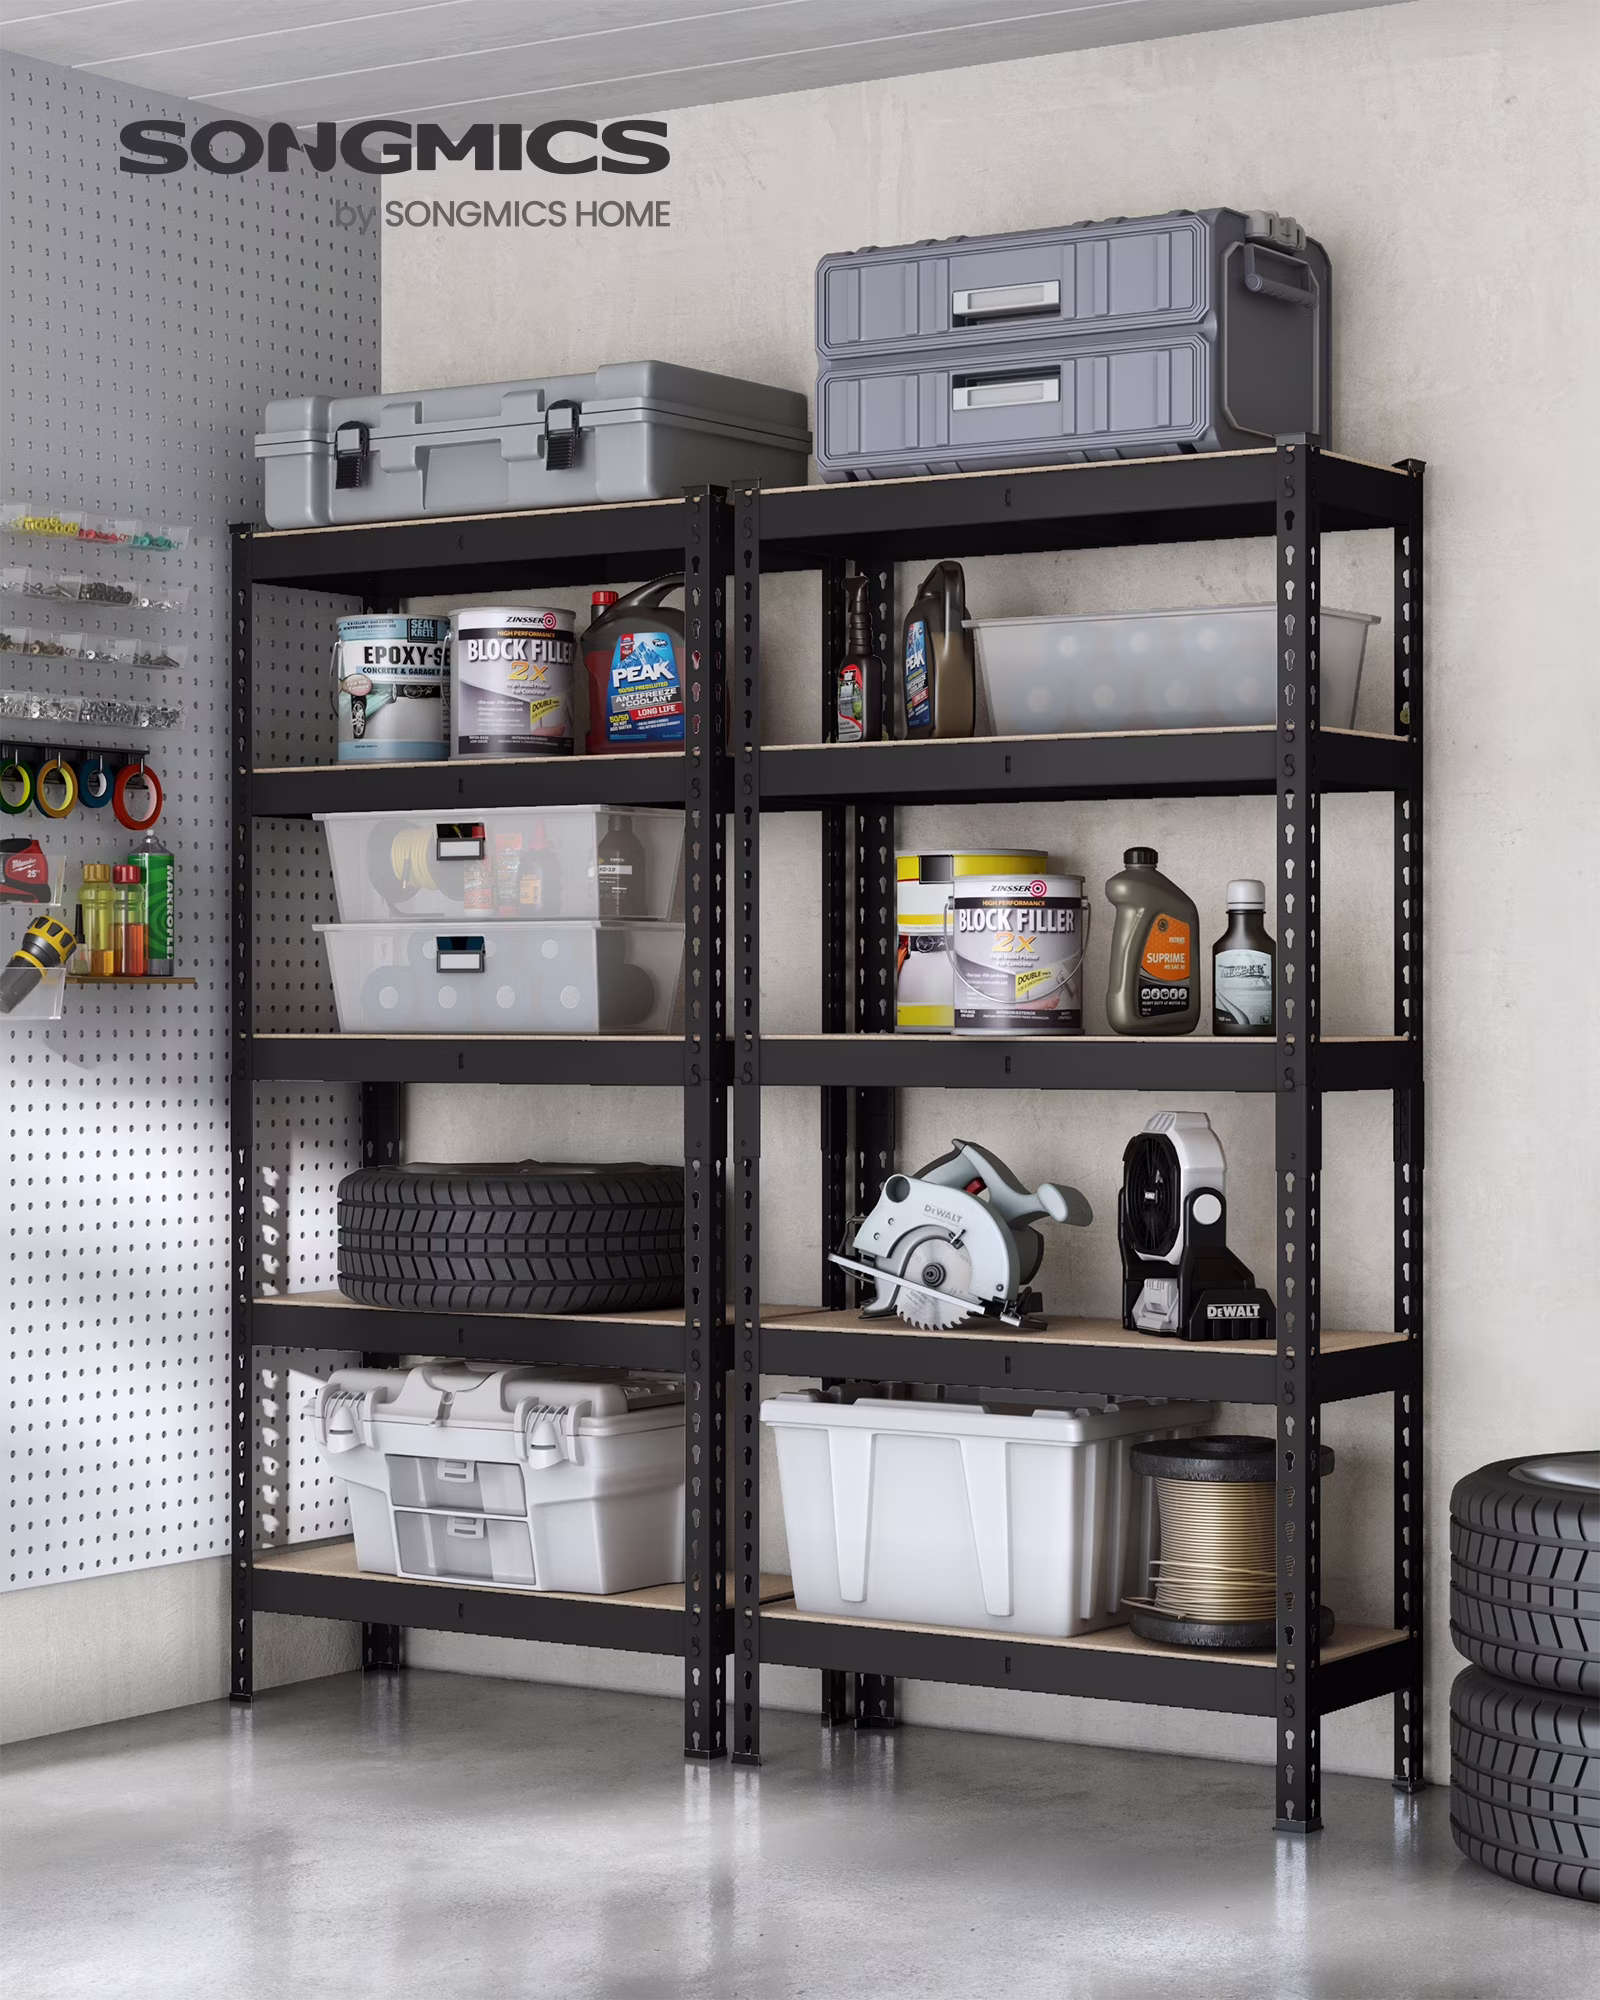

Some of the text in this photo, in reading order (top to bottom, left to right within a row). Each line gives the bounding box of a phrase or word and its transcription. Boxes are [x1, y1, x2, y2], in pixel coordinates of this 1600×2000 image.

[410, 619, 434, 629] SEAL
[411, 629, 435, 638] KRETE
[514, 630, 555, 638] PERFORMANCE
[467, 639, 527, 661] BLOCK
[906, 649, 926, 676] PEAK
[362, 667, 398, 675] CONCRETE
[408, 668, 436, 676] GARAGE
[612, 660, 676, 688] PEAK
[615, 688, 677, 703] ANTIFREEZE
[638, 707, 658, 717] LONG
[658, 705, 677, 713] LIFE
[609, 714, 629, 723] 50/50
[960, 908, 1074, 933] BLOCK FILLER
[1146, 952, 1185, 964] SUPRIME
[1018, 971, 1041, 985] DOUBLE
